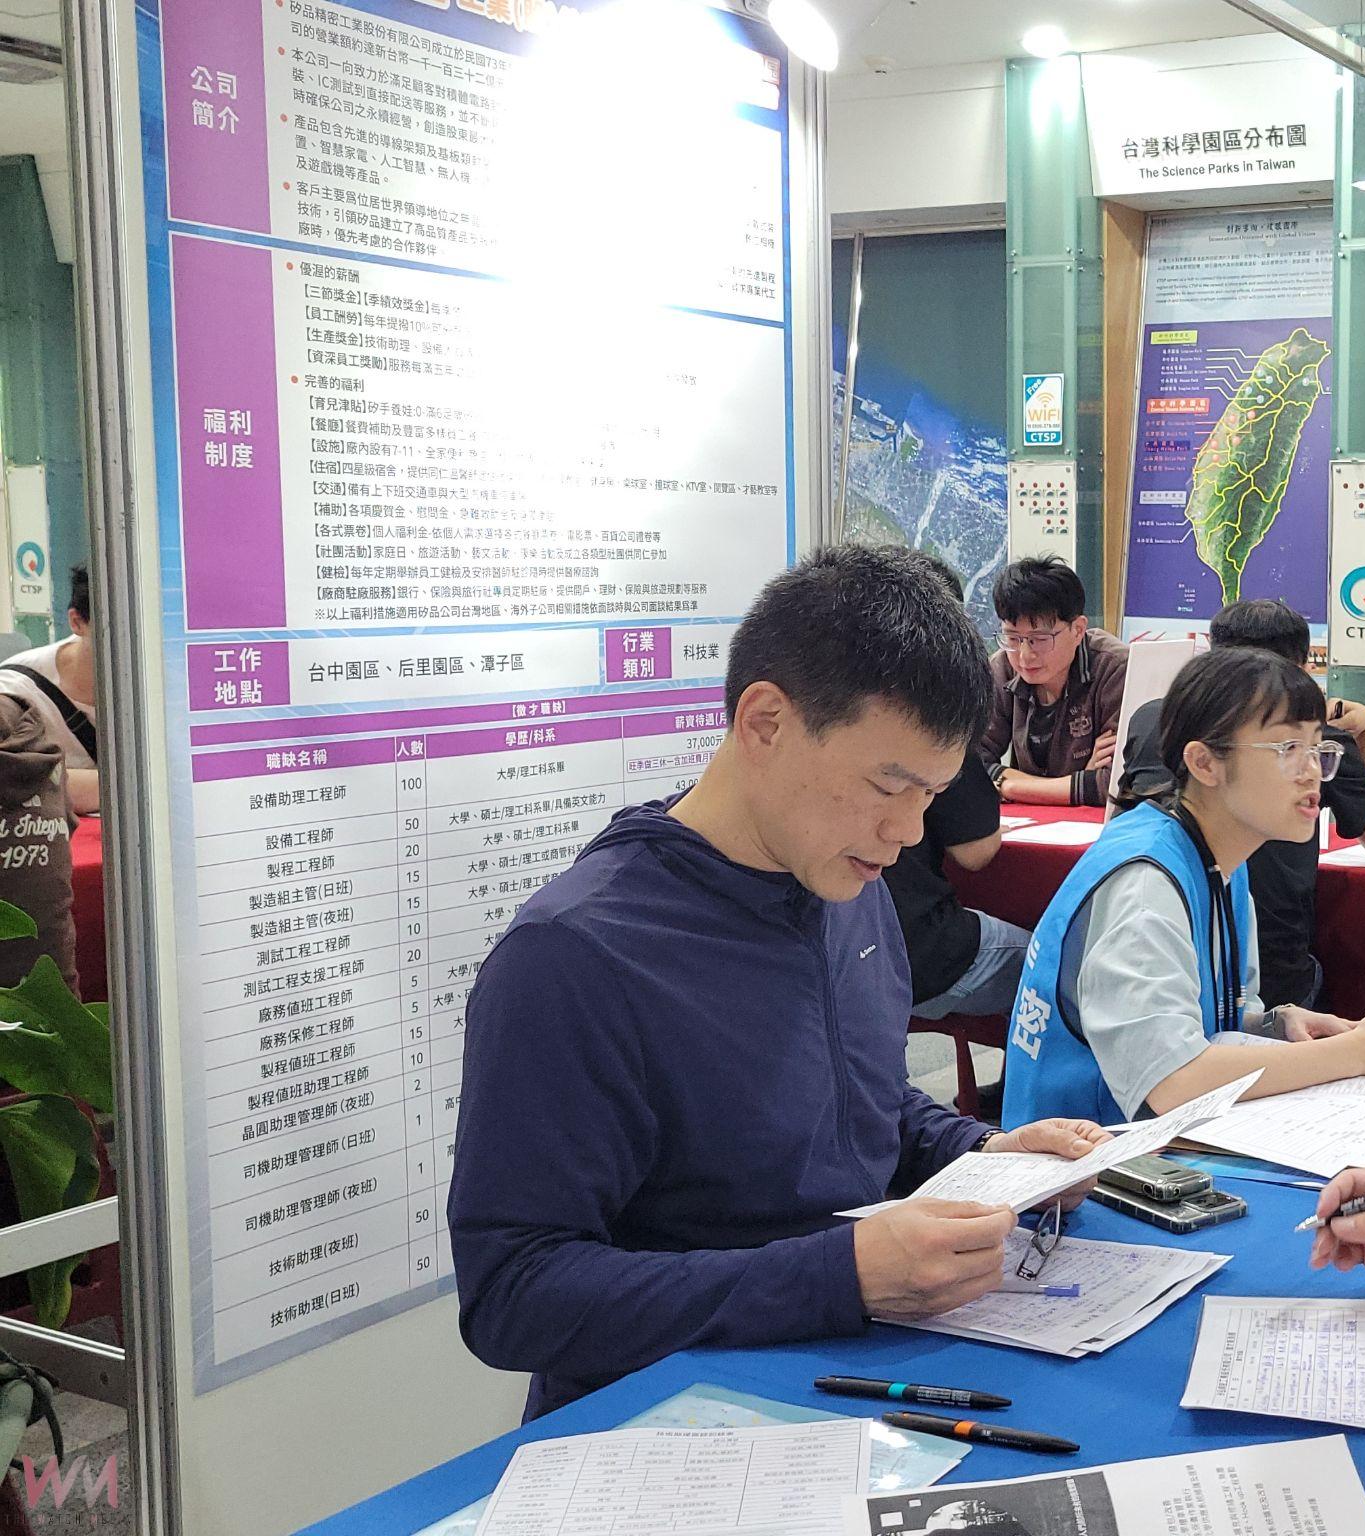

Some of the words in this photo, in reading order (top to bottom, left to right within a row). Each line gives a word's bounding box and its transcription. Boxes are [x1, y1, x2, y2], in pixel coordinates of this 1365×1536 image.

[190, 65, 238, 99] 公司
[191, 99, 240, 134] 簡介
[1121, 123, 1307, 160] 台灣科學園區分布圖
[1140, 167, 1159, 180] The
[1162, 164, 1205, 177] Science
[1208, 161, 1240, 174] Parks
[1243, 160, 1253, 171] in
[1256, 159, 1296, 171] Taiwan
[300, 261, 360, 284] 優渥的薪酬
[304, 375, 365, 393] 完善的福利
[203, 408, 253, 436] 福利
[1031, 432, 1057, 442] CTSP
[204, 442, 254, 468] 制度
[20, 584, 43, 595] CTSP
[623, 632, 654, 652] 行業
[213, 648, 262, 673] 工作
[683, 644, 720, 661] 科技業
[308, 653, 524, 683] 台中園區、后里園區、潭子區
[623, 658, 655, 678] 類別
[214, 680, 263, 705] 地點
[505, 729, 557, 747] 學歷/科系
[397, 740, 424, 757] 人數
[266, 749, 328, 770] 職缺名稱
[401, 777, 422, 791] 100
[249, 785, 347, 810] 設備助理工程師
[404, 816, 420, 831] 50
[265, 827, 335, 851] 設備工程師
[0, 844, 49, 869] 1973
[405, 843, 420, 857] 20
[267, 854, 335, 879] 製程工程師
[406, 870, 420, 883] 15
[248, 880, 353, 911] 製造組主管(日班)
[406, 896, 421, 910] 15
[250, 907, 354, 939] 製造組主管(夜班)
[407, 922, 421, 936] 10
[256, 935, 351, 967] 測試工程工程師
[407, 949, 421, 962] 20
[243, 959, 365, 999] 測試工程支援工程師
[411, 974, 418, 988] 5
[411, 1001, 419, 1015] 5
[259, 1016, 355, 1052] 廠務保修工程師
[409, 1026, 423, 1040] 15
[410, 1052, 424, 1066] 10
[414, 1079, 421, 1092] 2
[416, 1114, 421, 1127] 1
[418, 1162, 424, 1175] 1
[415, 1208, 429, 1223] 50
[268, 1233, 359, 1277] 技術助理(夜班)
[416, 1256, 430, 1271] 50
[270, 1281, 360, 1328] 技術助理(日班)
